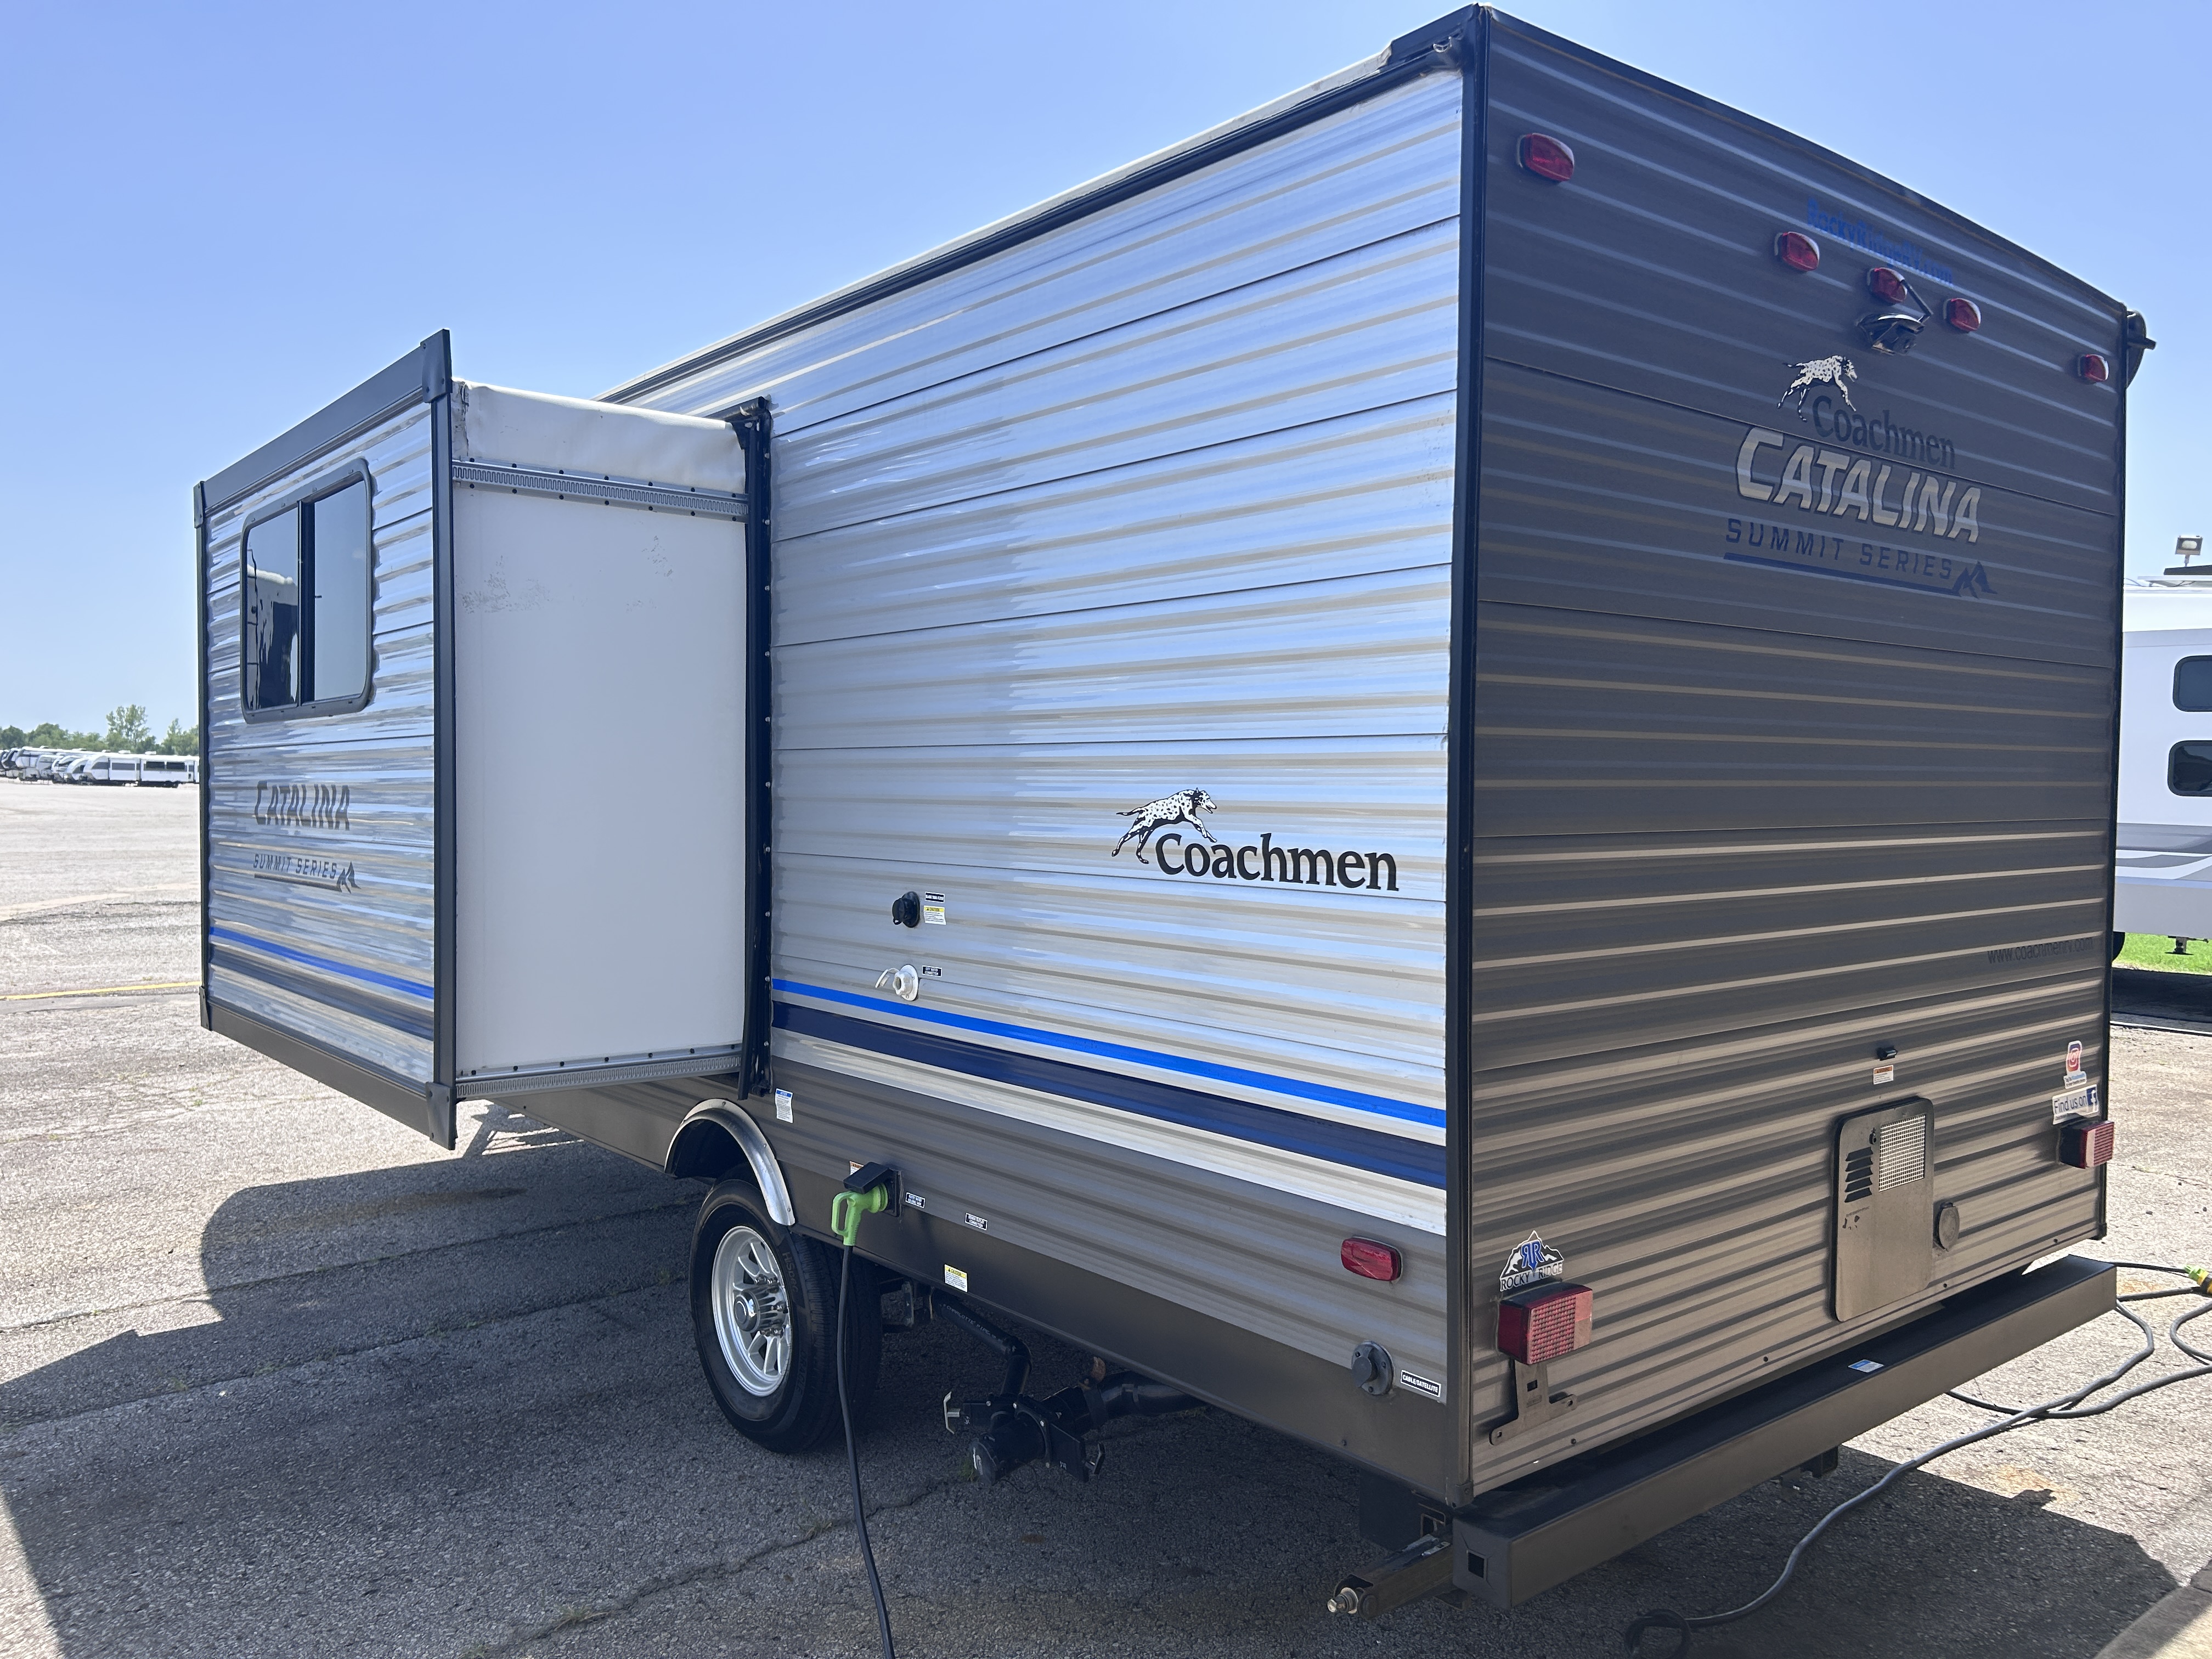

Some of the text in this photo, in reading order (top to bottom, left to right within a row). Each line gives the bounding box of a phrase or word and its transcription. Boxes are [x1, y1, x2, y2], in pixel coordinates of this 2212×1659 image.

[1812, 396, 1955, 469] Coachmen
[1736, 426, 1982, 544] CATALINA
[1726, 518, 1952, 579] SUMMIT SERIES
[254, 780, 350, 831] CATALINA
[253, 853, 337, 879] SUMMIT SERIES
[1155, 832, 1399, 891] Coachmen
[2054, 1096, 2069, 1114] Find
[2069, 1098, 2078, 1109] us
[2079, 1095, 2087, 1107] on
[1501, 1262, 1562, 1290] ROCKY RIDGE
[1402, 1374, 1438, 1393] CABLE/SATELLITE
